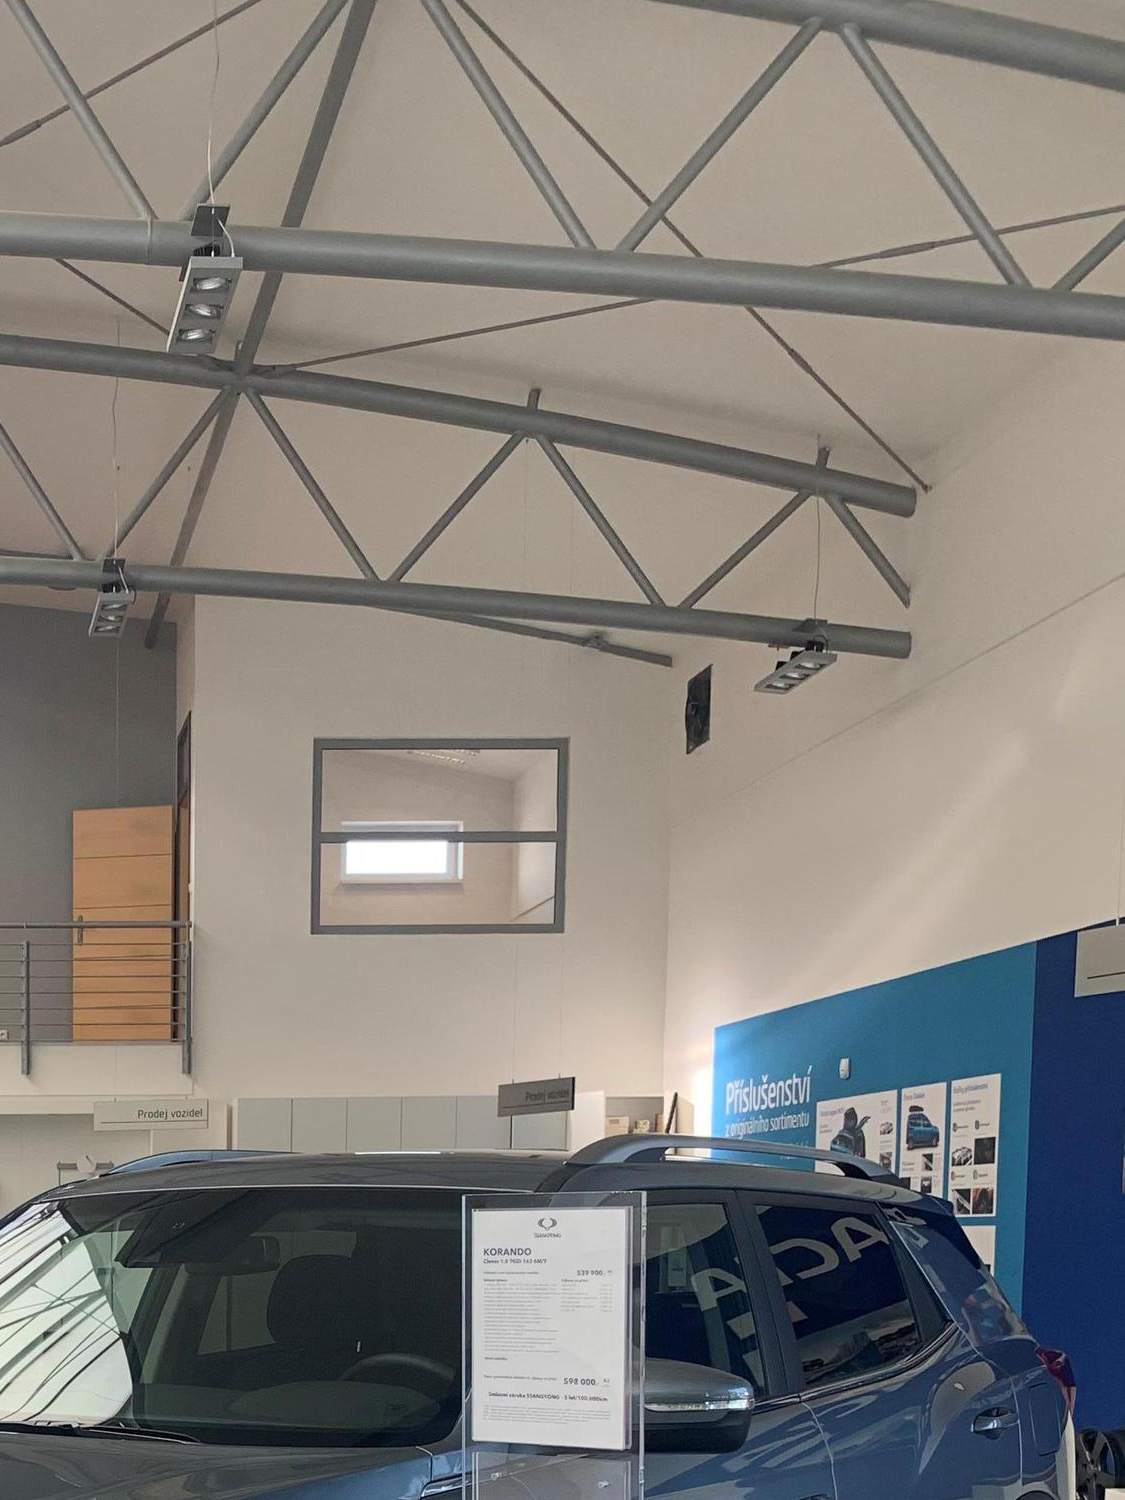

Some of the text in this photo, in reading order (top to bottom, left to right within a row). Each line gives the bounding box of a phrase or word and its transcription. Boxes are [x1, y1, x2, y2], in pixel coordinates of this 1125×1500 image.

[725, 1065, 812, 1115] Příslušenství
[137, 1108, 203, 1120] Prodej vozidel
[770, 1110, 810, 1132] sortimentu
[483, 1247, 532, 1257] KORANDO
